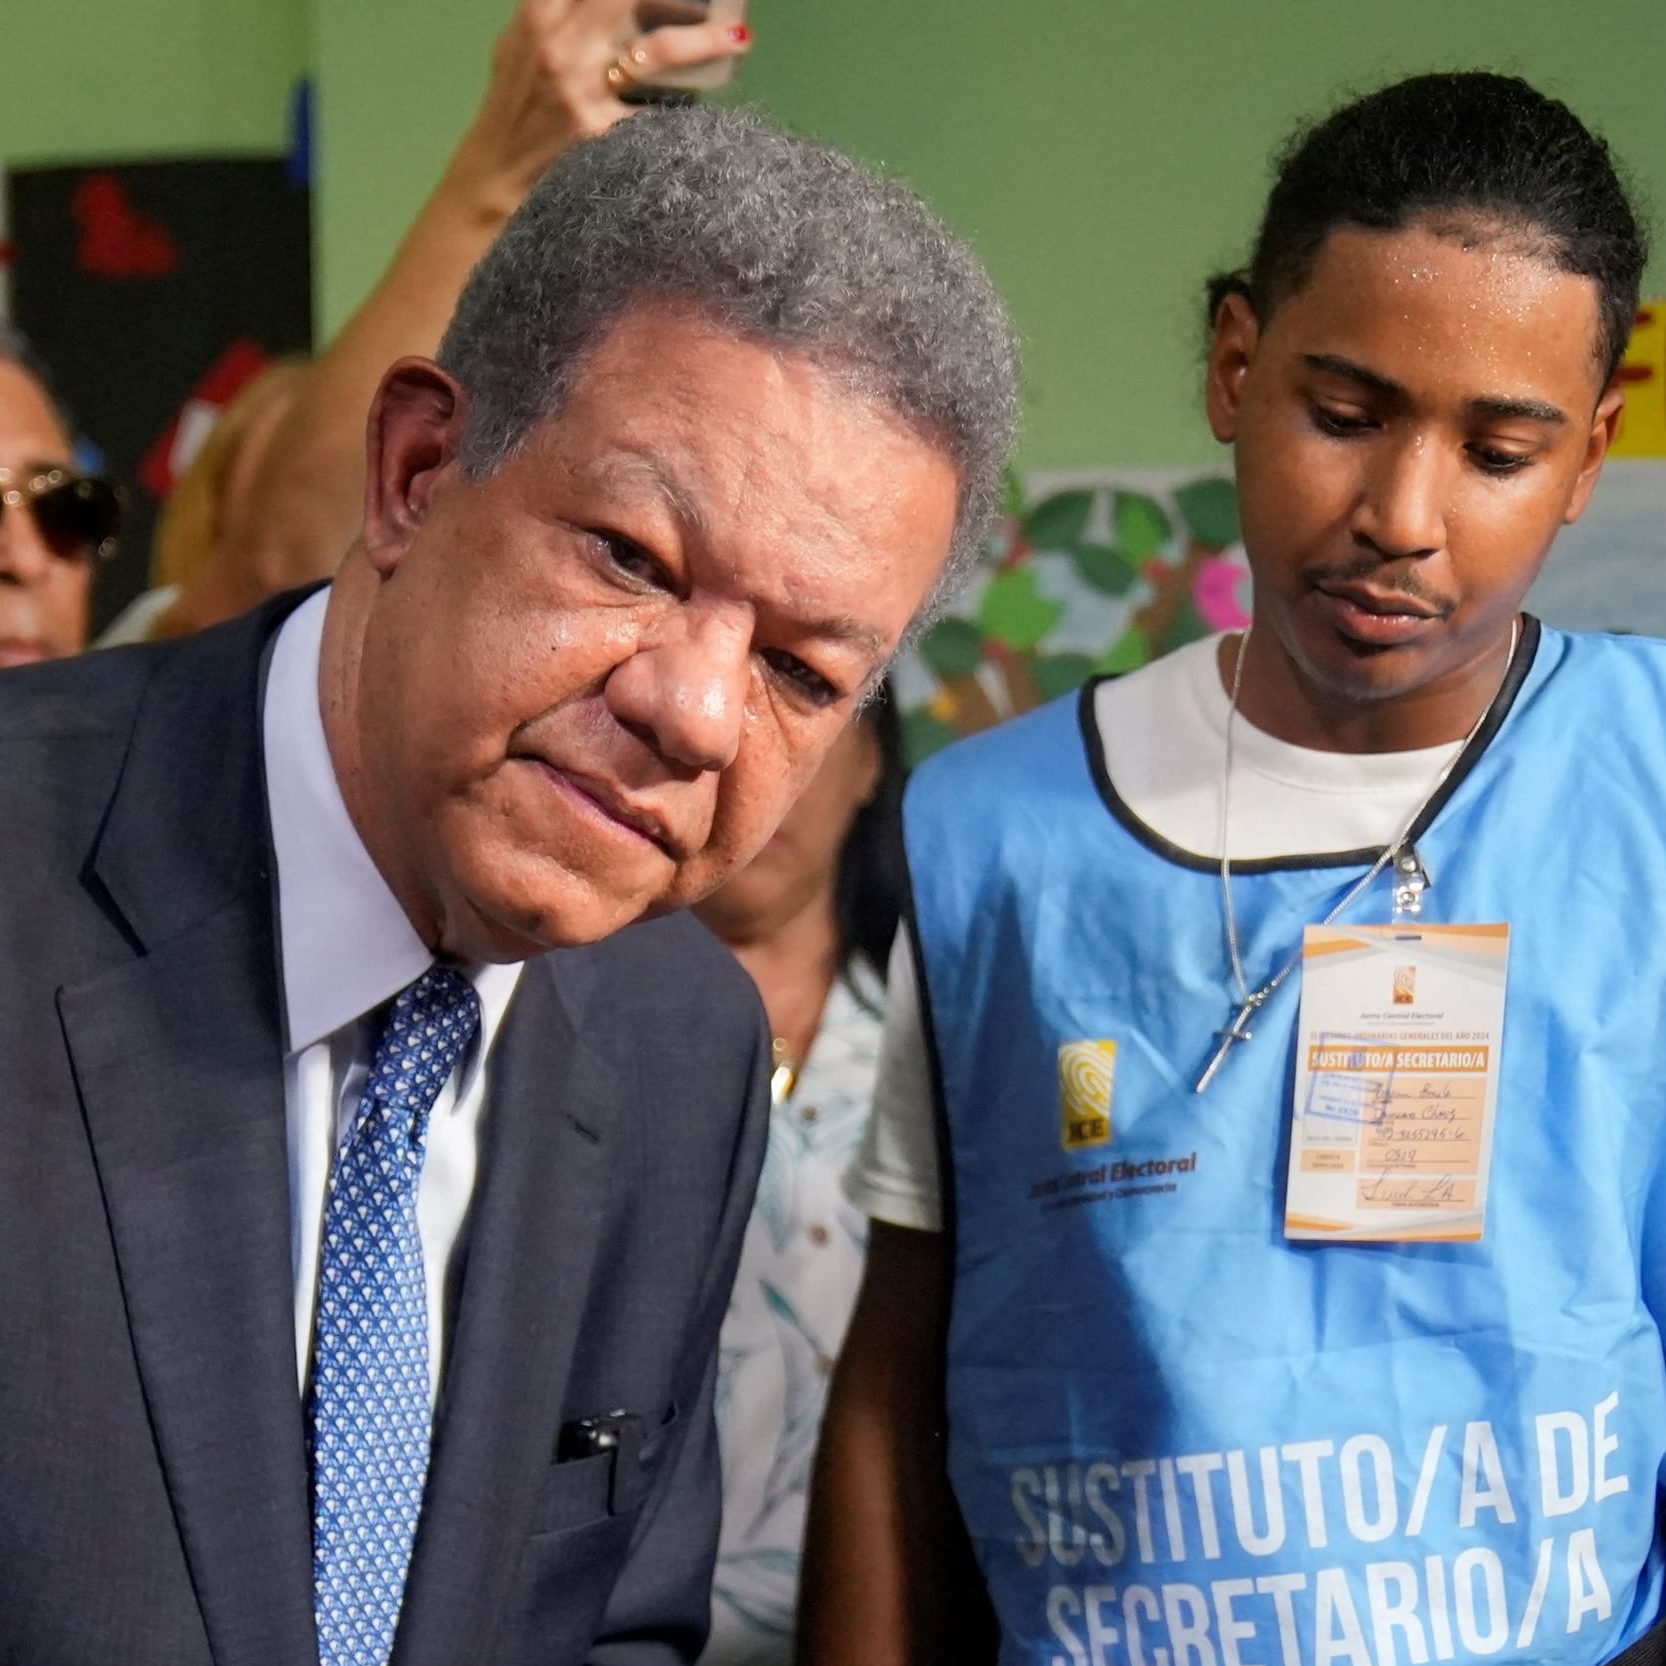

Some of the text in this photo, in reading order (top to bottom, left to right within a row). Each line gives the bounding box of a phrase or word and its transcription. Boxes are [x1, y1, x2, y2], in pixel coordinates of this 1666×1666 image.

[1399, 1031, 1439, 1041] GENERALES
[1440, 1031, 1454, 1041] DEL
[1455, 1029, 1471, 1041] AÑO
[1472, 1031, 1490, 1040] 2024
[1311, 1051, 1485, 1068] SUSTITUTO/A SECRETARIO/A
[1110, 1151, 1197, 1182] Electoral
[1009, 1389, 1630, 1569] SUSTITUTO/A DE
